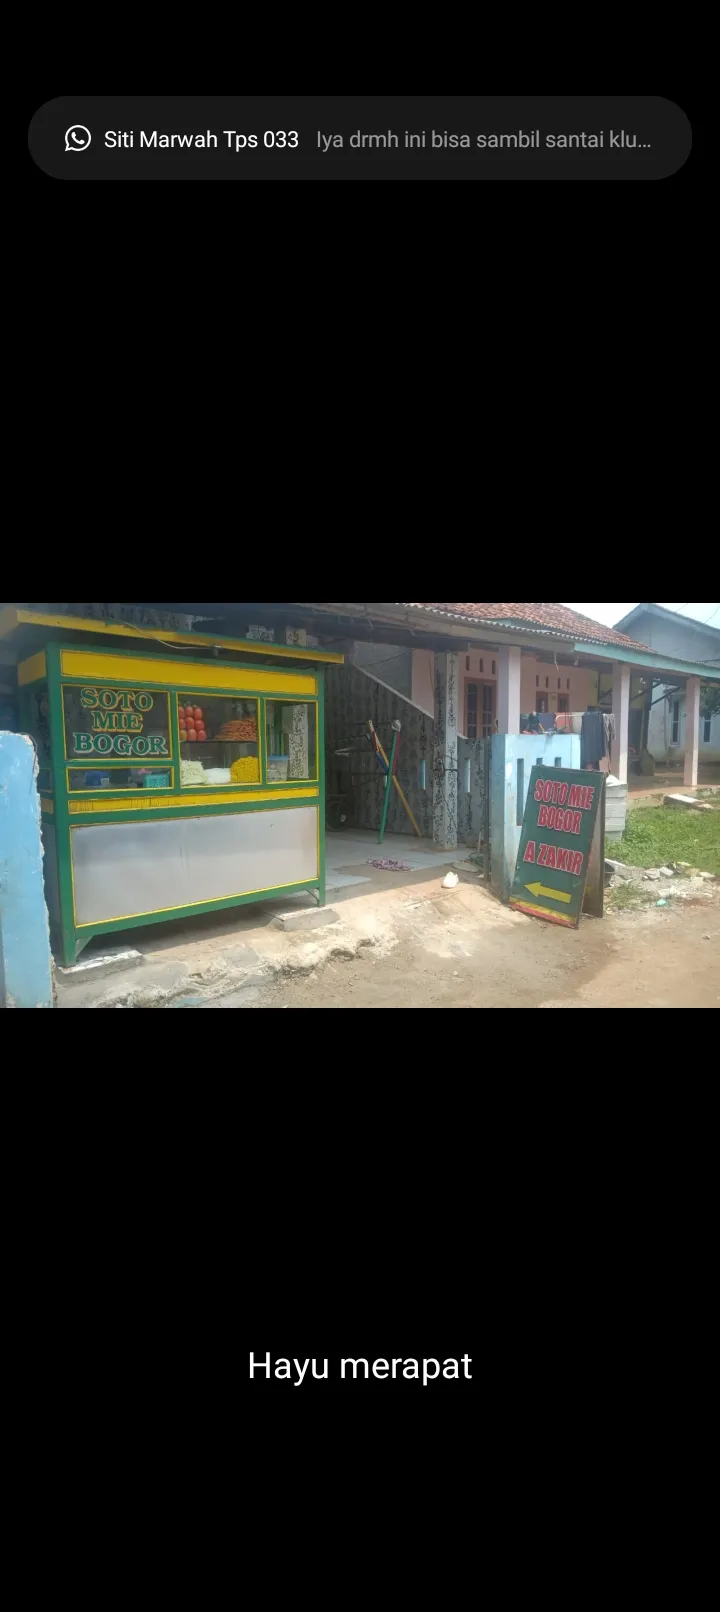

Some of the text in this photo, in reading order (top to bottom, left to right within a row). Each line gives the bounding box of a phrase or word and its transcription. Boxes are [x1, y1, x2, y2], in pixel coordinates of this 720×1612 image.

[80, 687, 153, 712] SOTO
[91, 711, 144, 733] MIE
[73, 732, 168, 756] BOGOR
[534, 779, 595, 810] SOTO MIE
[537, 805, 583, 834] BOGOR
[523, 840, 584, 875] A ZAKIR
